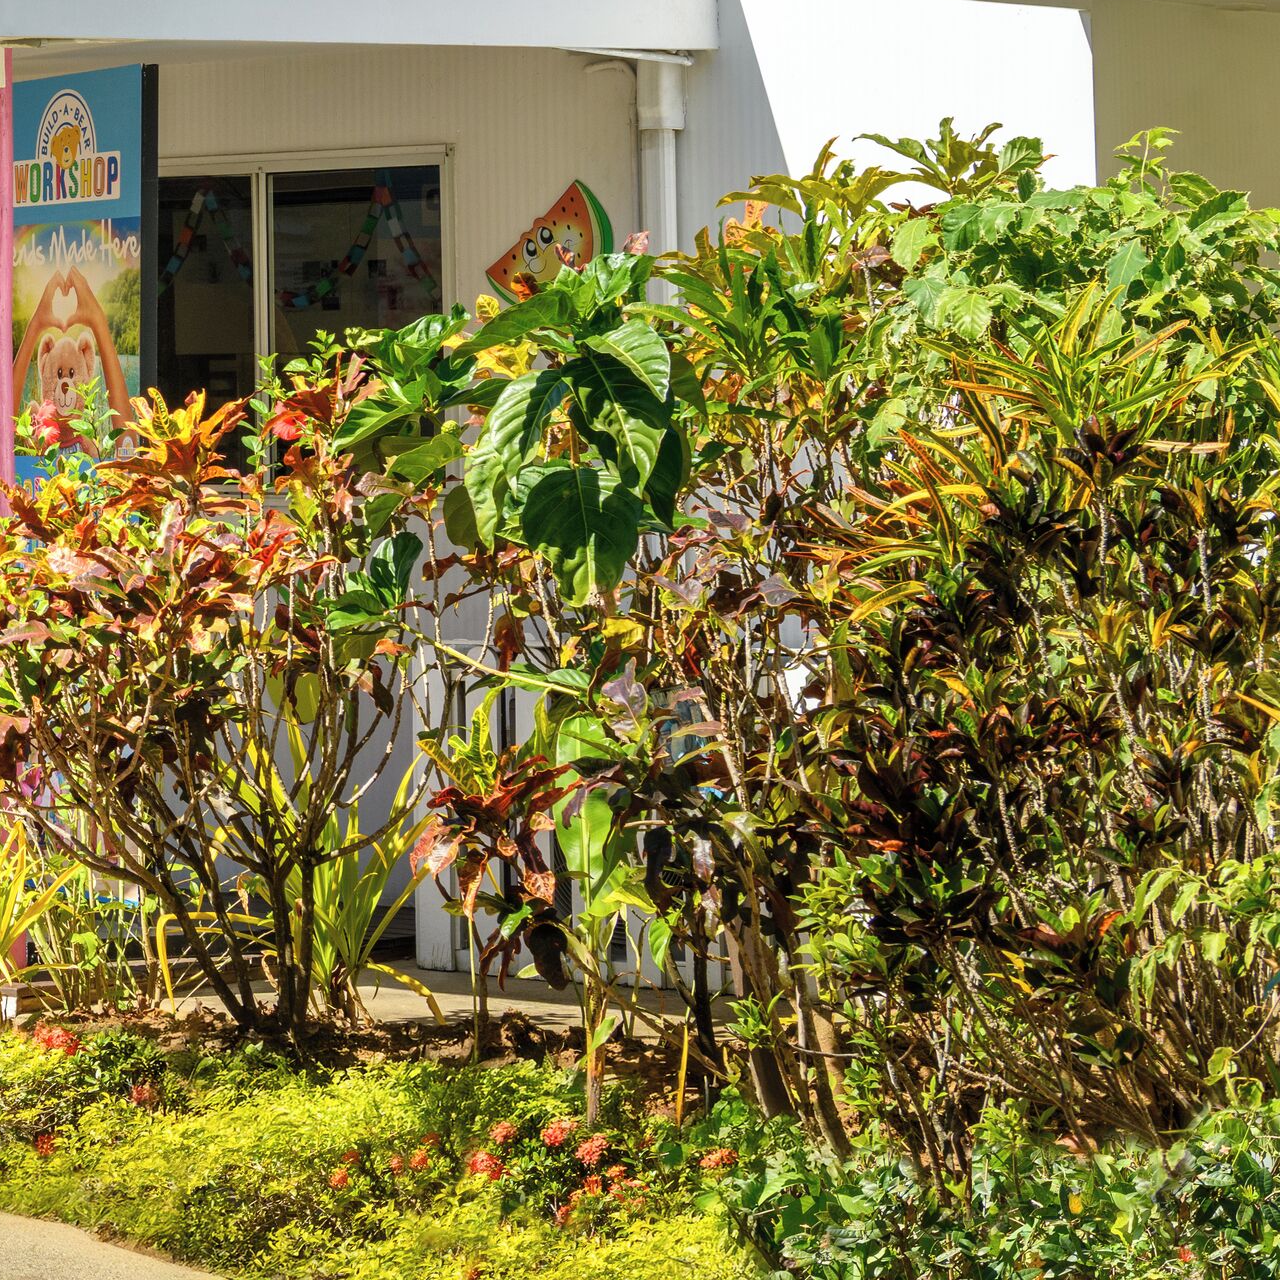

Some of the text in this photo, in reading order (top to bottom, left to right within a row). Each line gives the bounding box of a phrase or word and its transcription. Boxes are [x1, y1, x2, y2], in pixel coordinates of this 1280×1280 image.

[15, 156, 119, 204] WORKSHOP
[13, 218, 141, 267] ends Made Here
